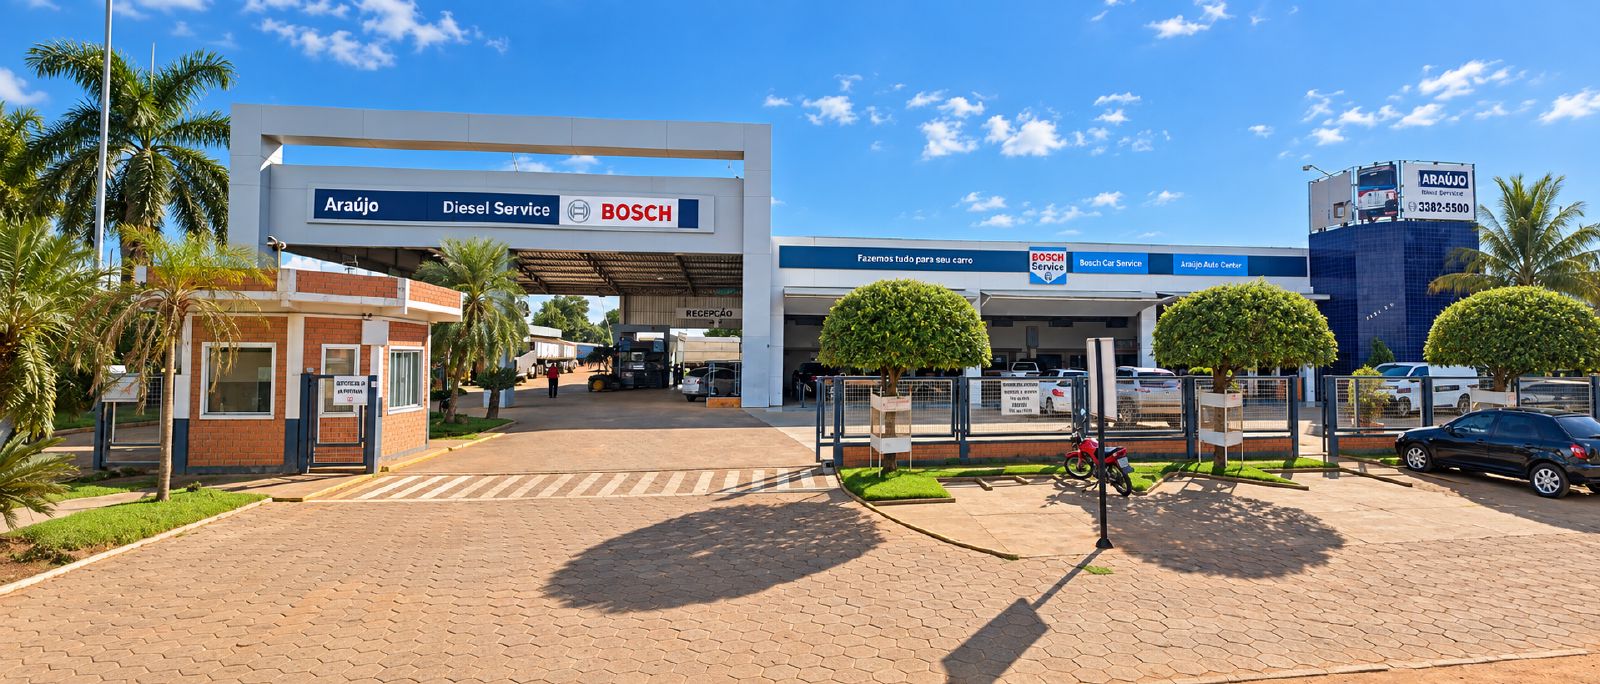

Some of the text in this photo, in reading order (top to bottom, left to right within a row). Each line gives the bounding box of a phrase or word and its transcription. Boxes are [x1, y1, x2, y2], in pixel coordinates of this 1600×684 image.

[1422, 171, 1467, 187] ARAÚJO
[324, 196, 551, 217] Araújo Diesel Service
[601, 203, 672, 222] BOSCH
[1418, 201, 1470, 213] 3382-5500
[857, 253, 974, 265] Fazemos tudo para seu carro
[1031, 253, 1064, 262] BOSCH
[1079, 258, 1143, 268] Bosch Car Service
[1031, 262, 1065, 271] Service
[1203, 260, 1219, 269] Auto
